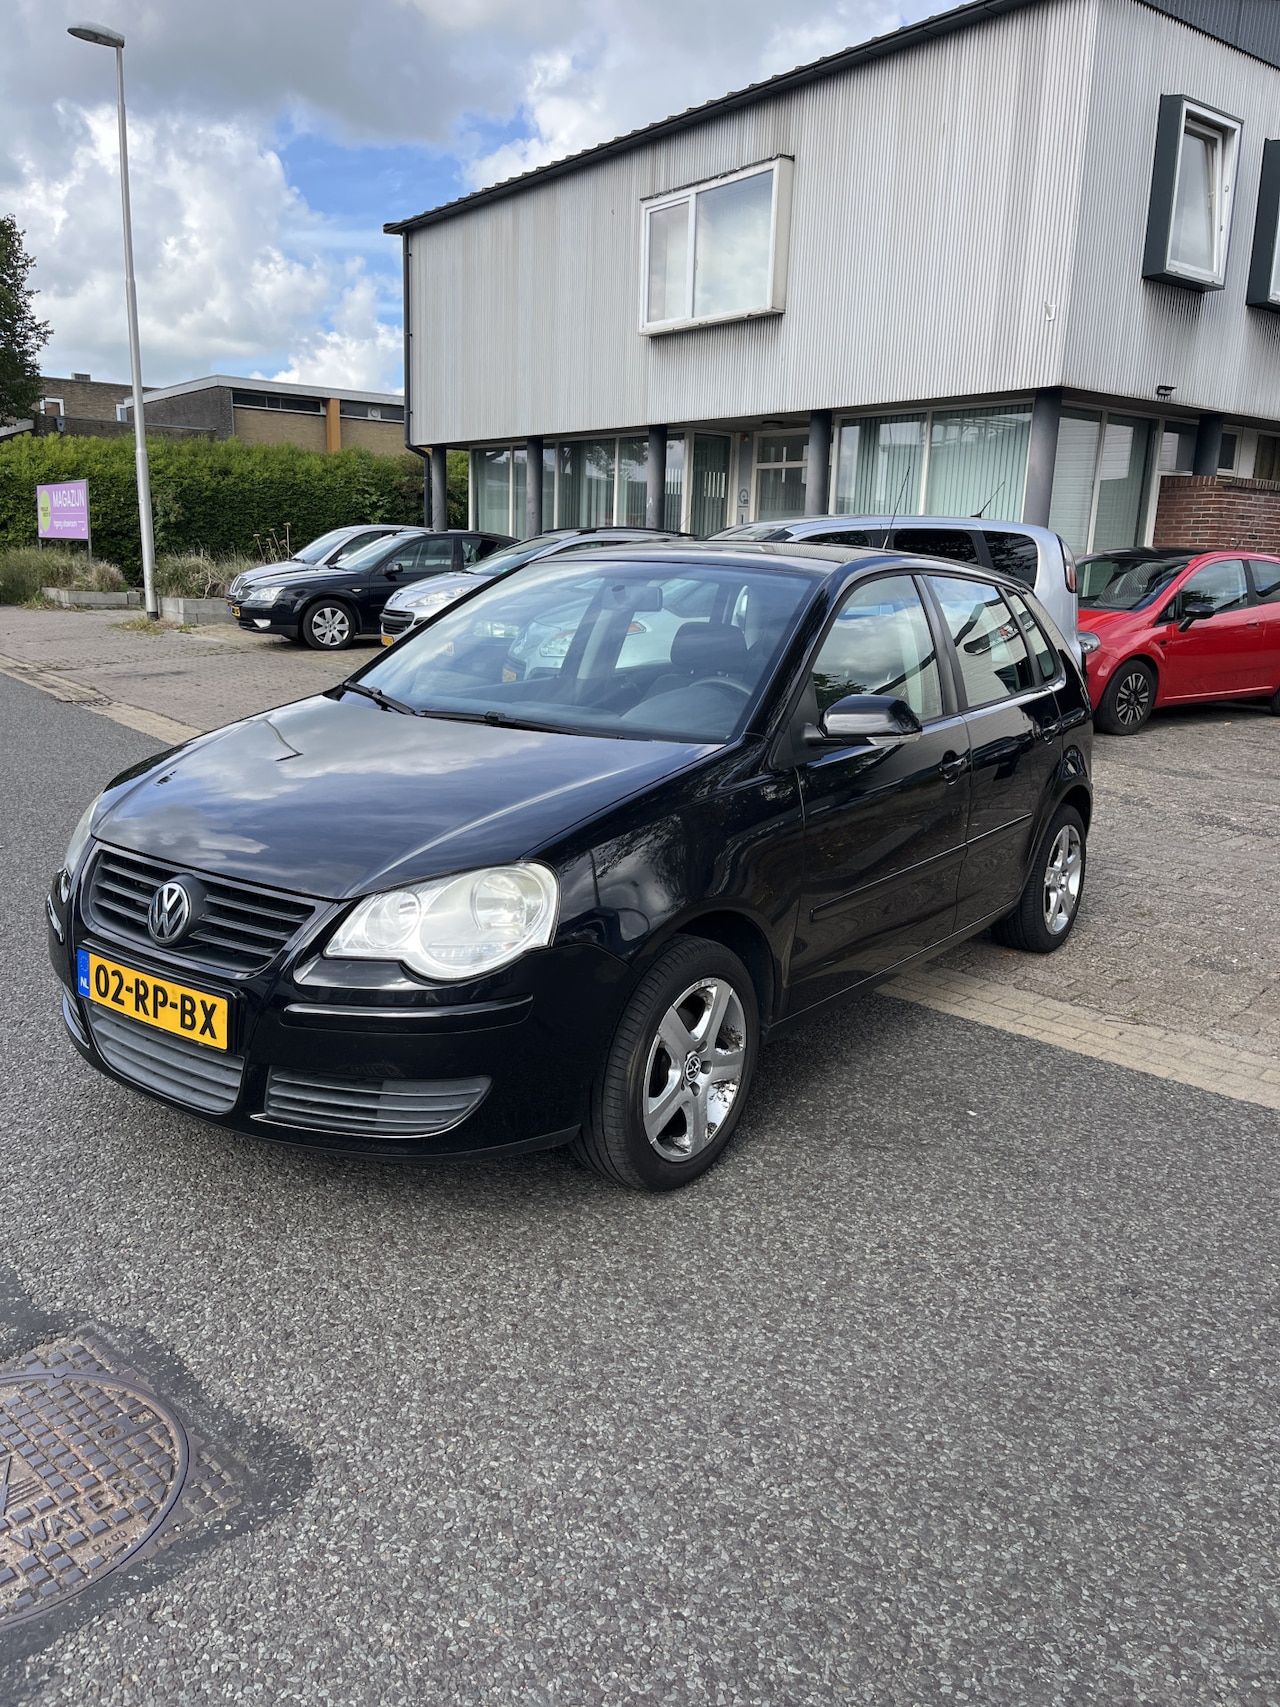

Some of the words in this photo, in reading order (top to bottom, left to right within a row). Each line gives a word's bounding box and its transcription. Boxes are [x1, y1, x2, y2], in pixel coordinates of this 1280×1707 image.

[52, 489, 85, 508] MAGAZIJN
[80, 976, 90, 989] NL
[94, 963, 218, 1040] 02-RP-BX
[8, 1478, 138, 1551] WATER
